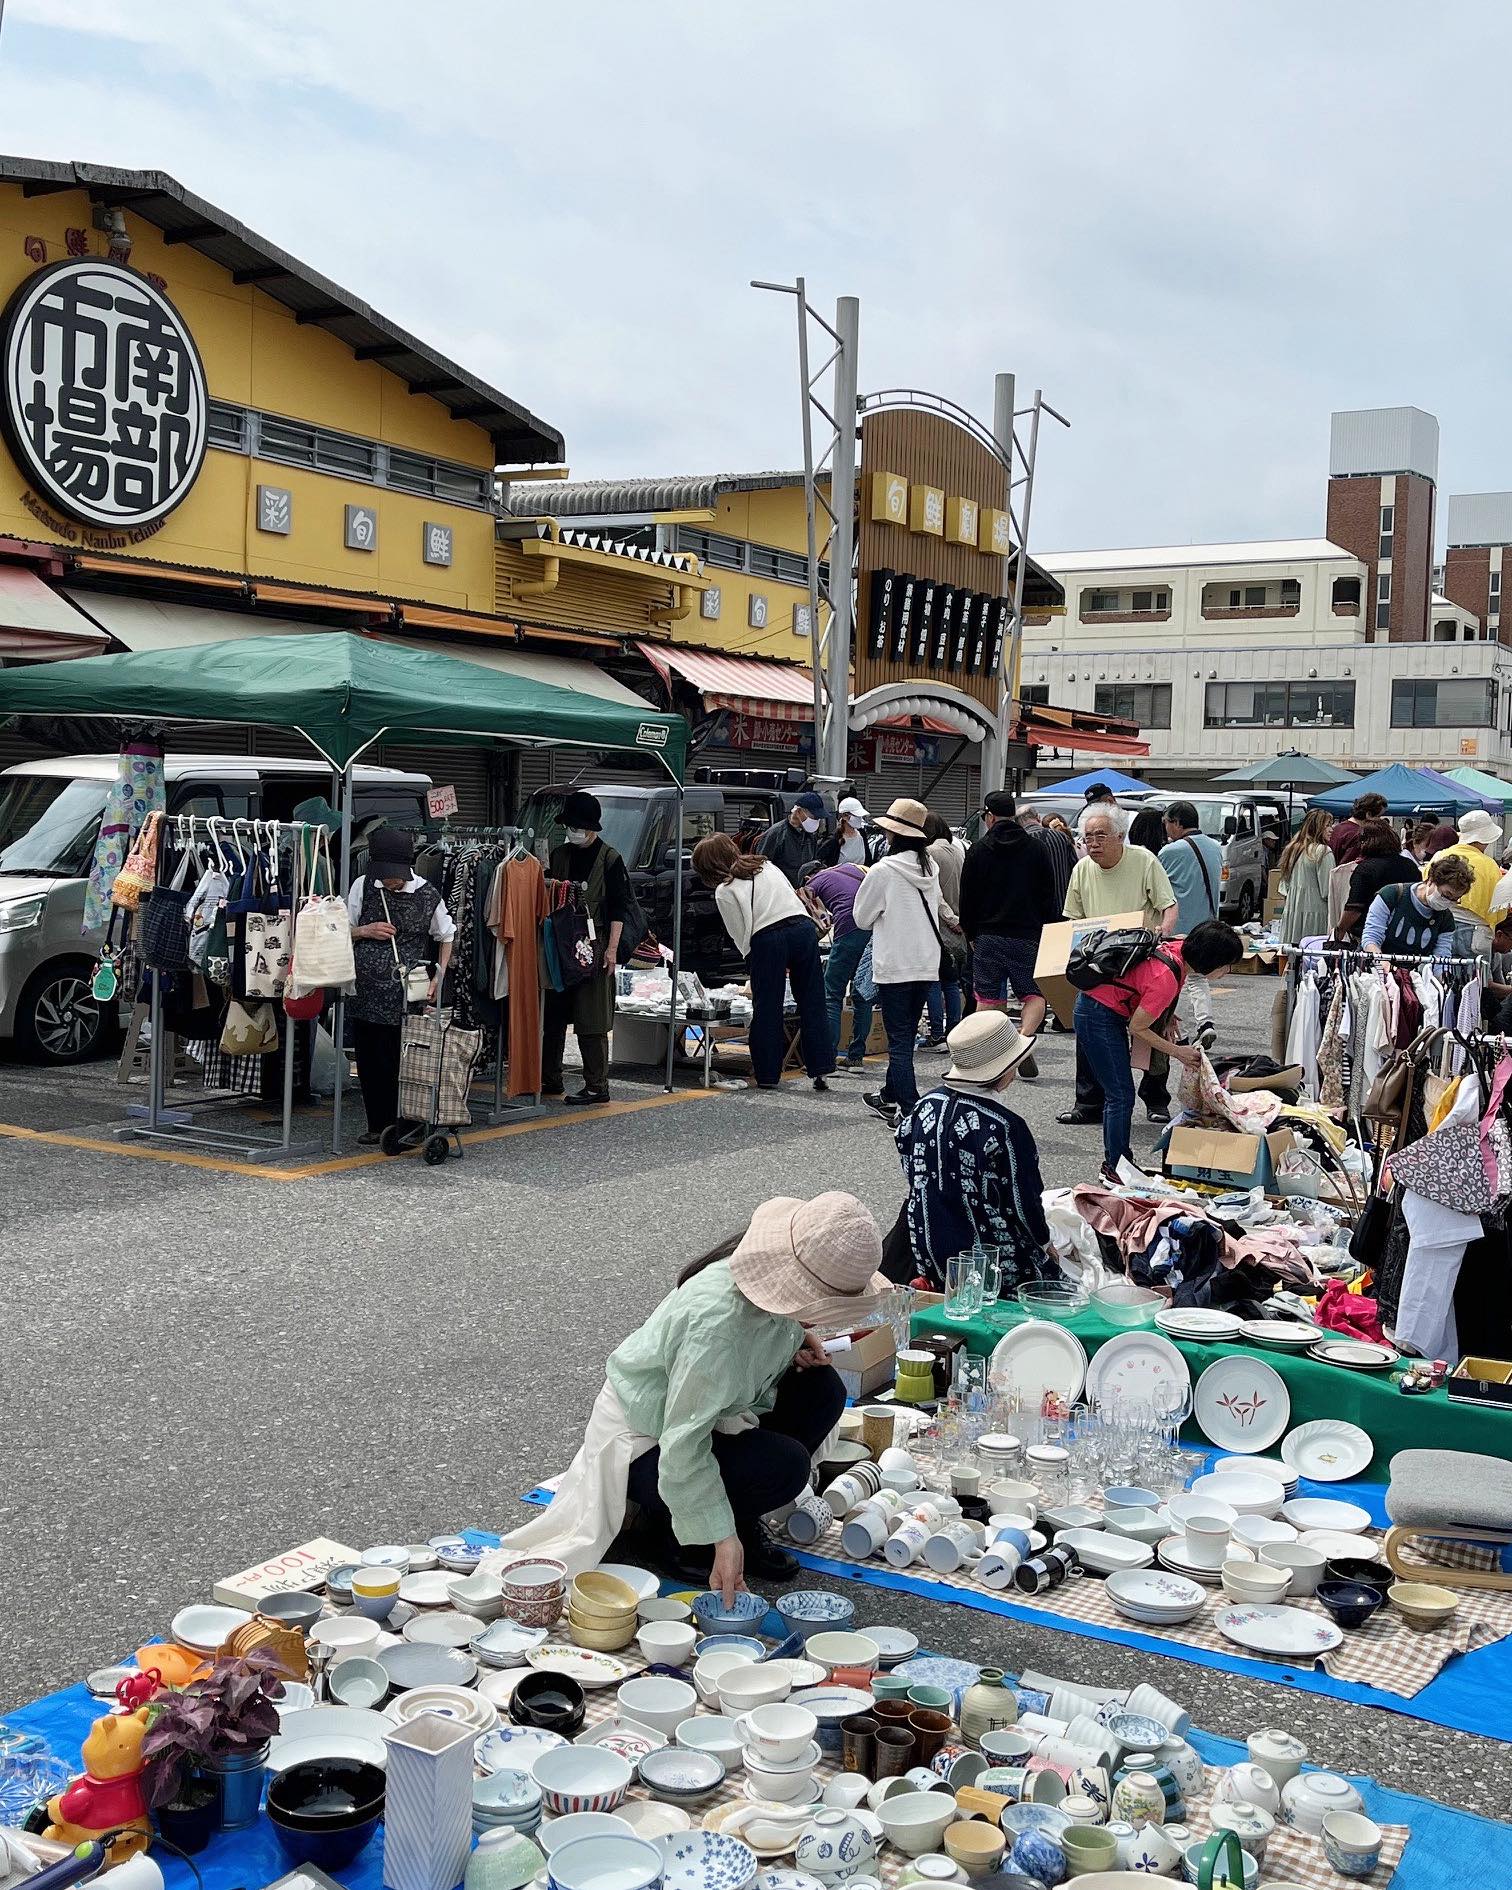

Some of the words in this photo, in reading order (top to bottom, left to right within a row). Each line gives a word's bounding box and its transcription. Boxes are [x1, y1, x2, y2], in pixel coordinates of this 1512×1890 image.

[19, 490, 77, 542] Matsudo
[264, 490, 289, 527] 彩
[352, 510, 374, 545] 旬
[430, 527, 449, 560] 鮮
[754, 599, 766, 624] 旬
[876, 578, 892, 649] のり・お茶
[732, 712, 750, 745] 米
[430, 799, 444, 813] 500
